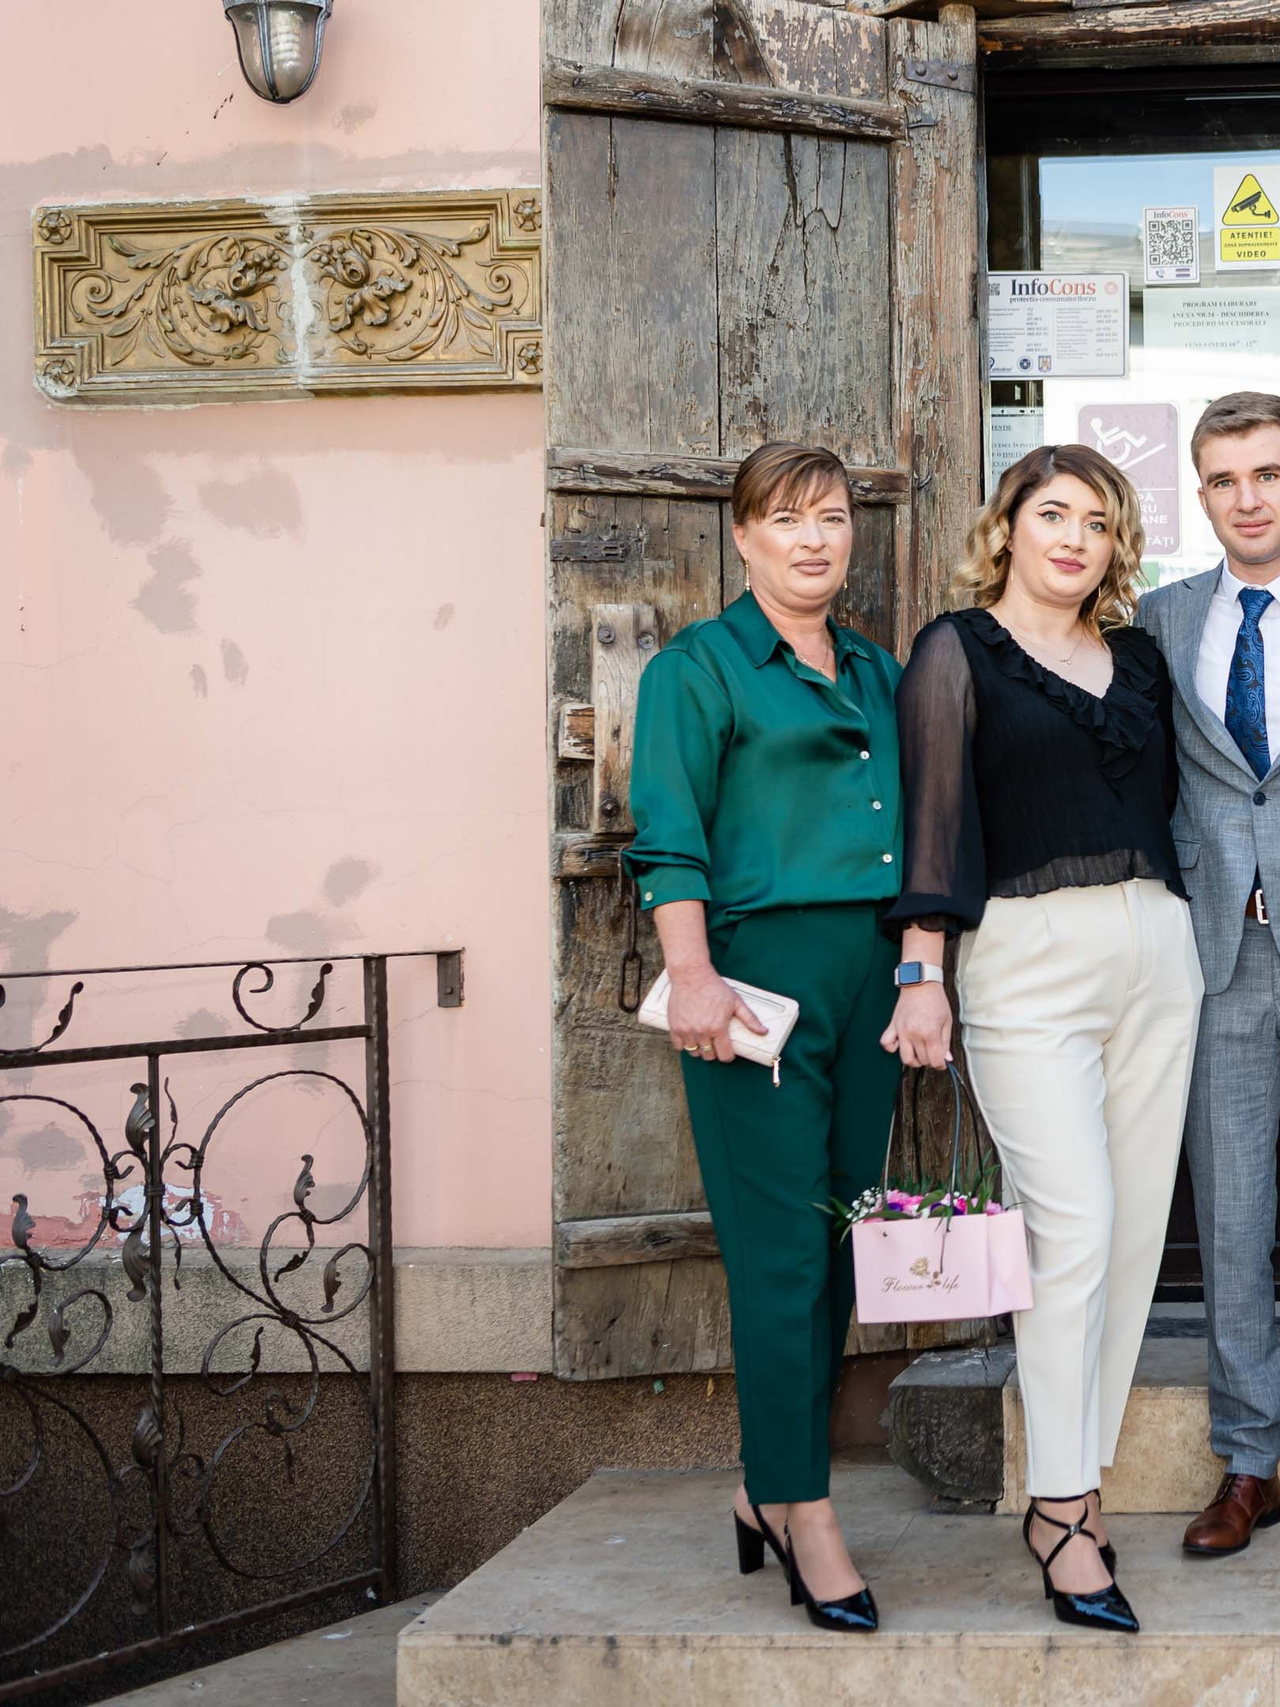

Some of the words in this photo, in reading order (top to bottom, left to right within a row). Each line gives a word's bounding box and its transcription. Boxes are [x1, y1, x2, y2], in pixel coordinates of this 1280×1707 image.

[1153, 211, 1188, 219] InfoCons
[1236, 250, 1267, 258] VIDEO
[1010, 278, 1096, 296] InfoCons
[942, 1274, 960, 1295] life
